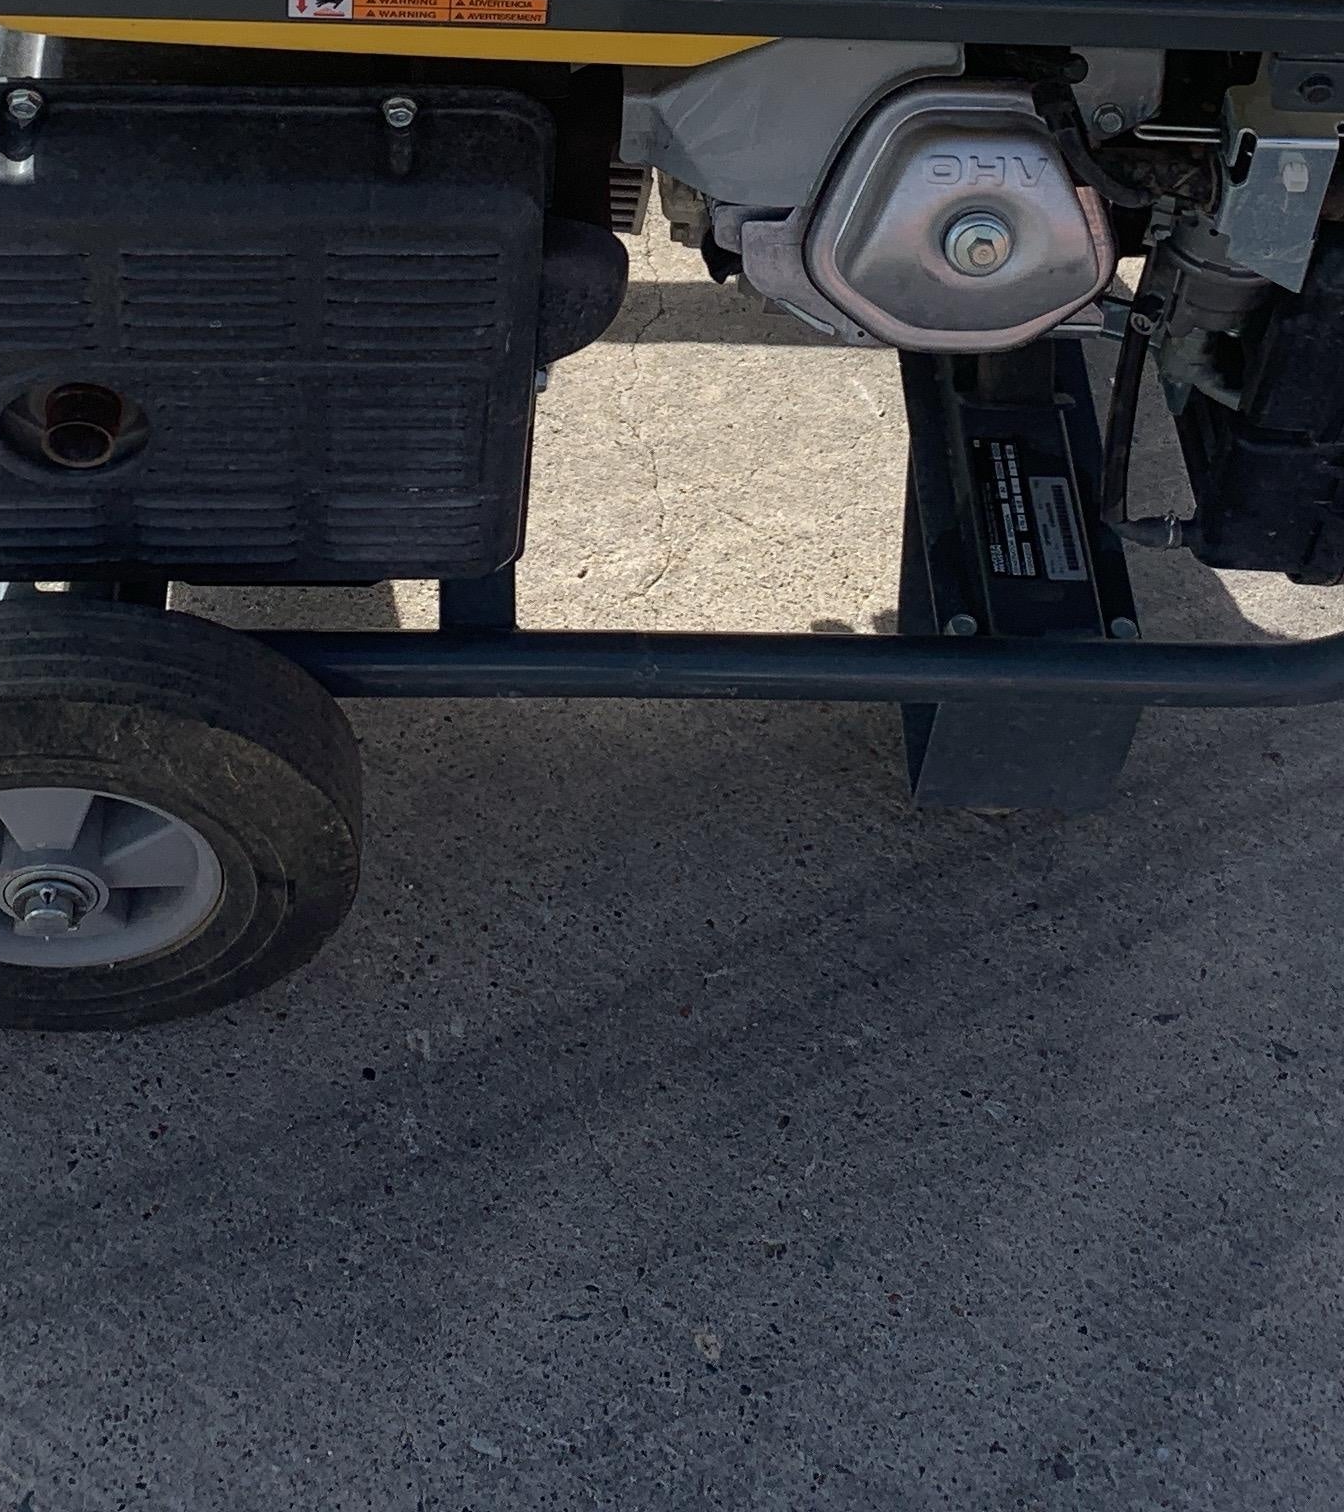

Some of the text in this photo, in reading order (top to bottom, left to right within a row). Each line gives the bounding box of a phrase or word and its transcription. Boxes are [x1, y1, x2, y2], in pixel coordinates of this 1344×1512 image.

[468, 0, 533, 8] ADVERTENCIA
[378, 10, 436, 19] WARNING
[467, 12, 542, 22] AVERTISSEMENT
[925, 154, 1049, 187] OHV
